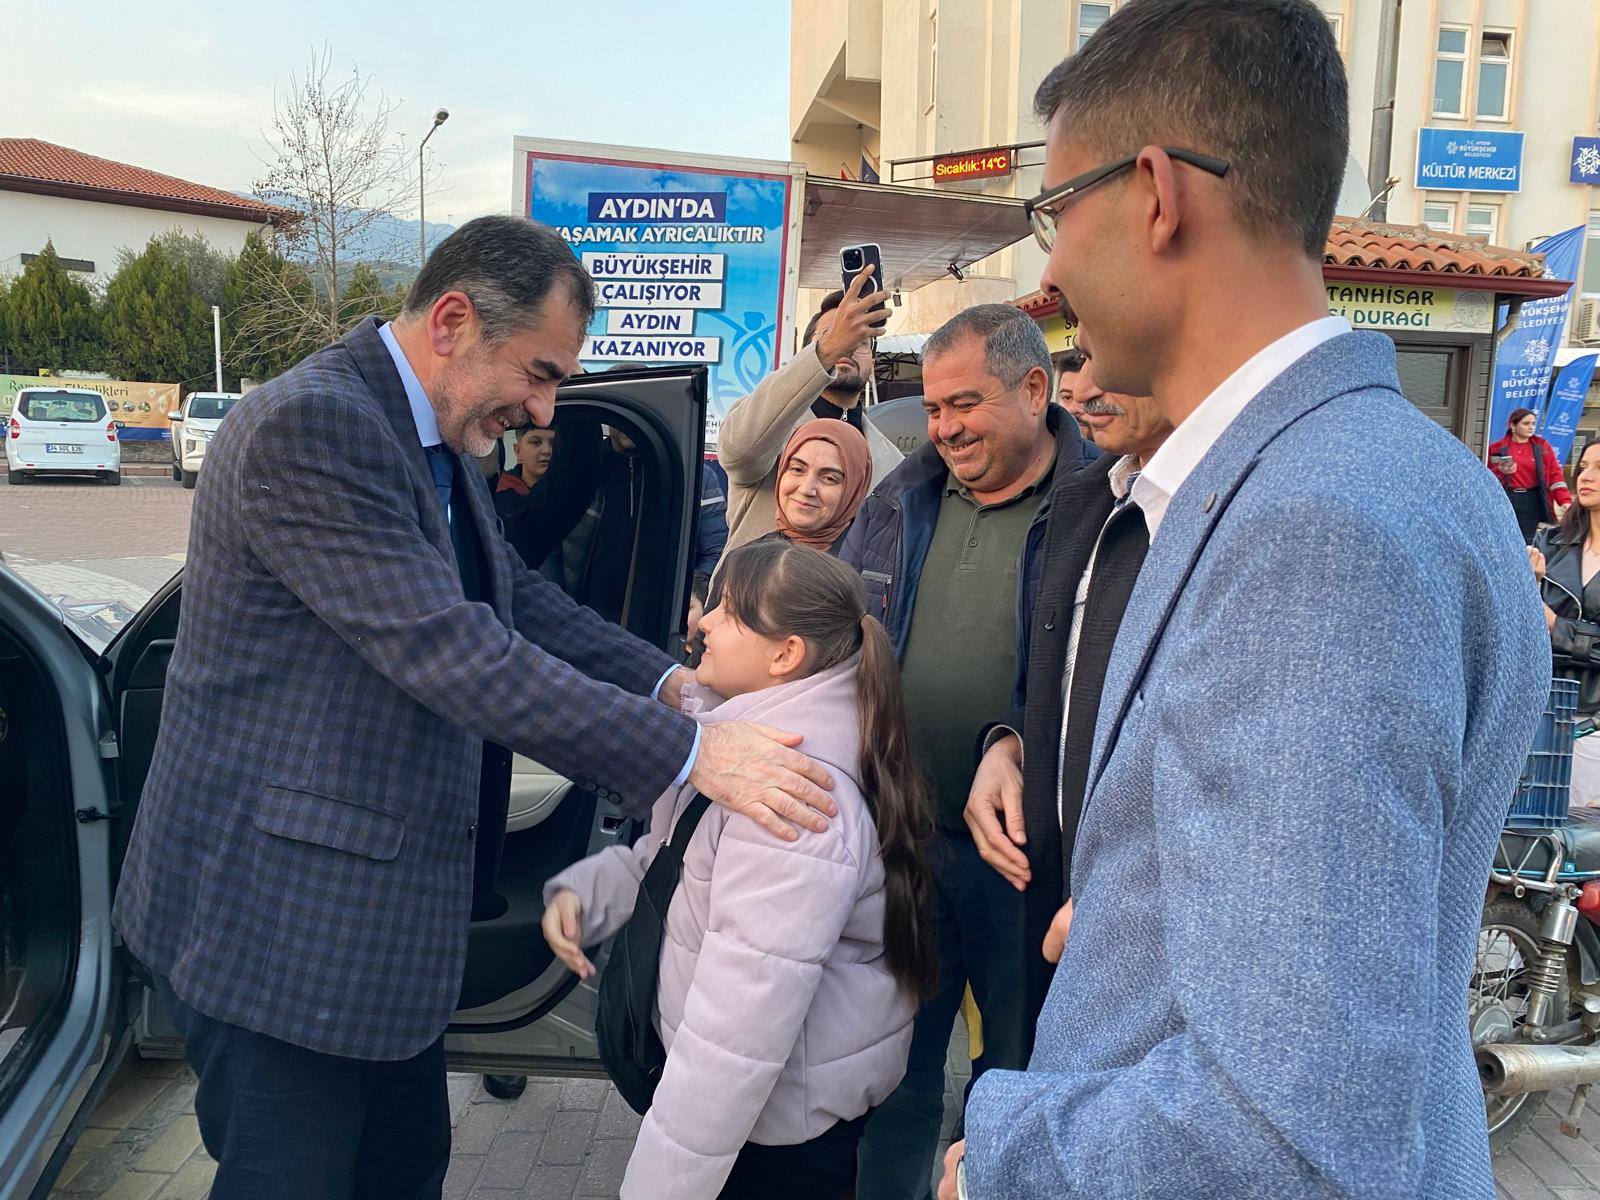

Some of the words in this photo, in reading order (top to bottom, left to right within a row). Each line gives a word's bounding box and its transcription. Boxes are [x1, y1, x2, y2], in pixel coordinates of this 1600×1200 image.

[1422, 162, 1465, 178] KÜLTÜR
[1468, 165, 1517, 180] MERKEZİ
[599, 198, 715, 219] AYDIN'DA
[640, 226, 765, 243] AYRICALIKTIR
[592, 254, 712, 278] BÜYÜKŞEHİR
[602, 284, 701, 305] ÇALIŞIYOR
[1327, 285, 1435, 306] TANHİSAR
[620, 313, 681, 330] AYDIN
[1353, 309, 1431, 327] DURAĞI
[592, 340, 706, 357] KAZANIYOR
[1531, 366, 1550, 376] AYD
[1502, 376, 1550, 388] BÜYÜKŞE
[1505, 388, 1546, 399] BELEDİY
